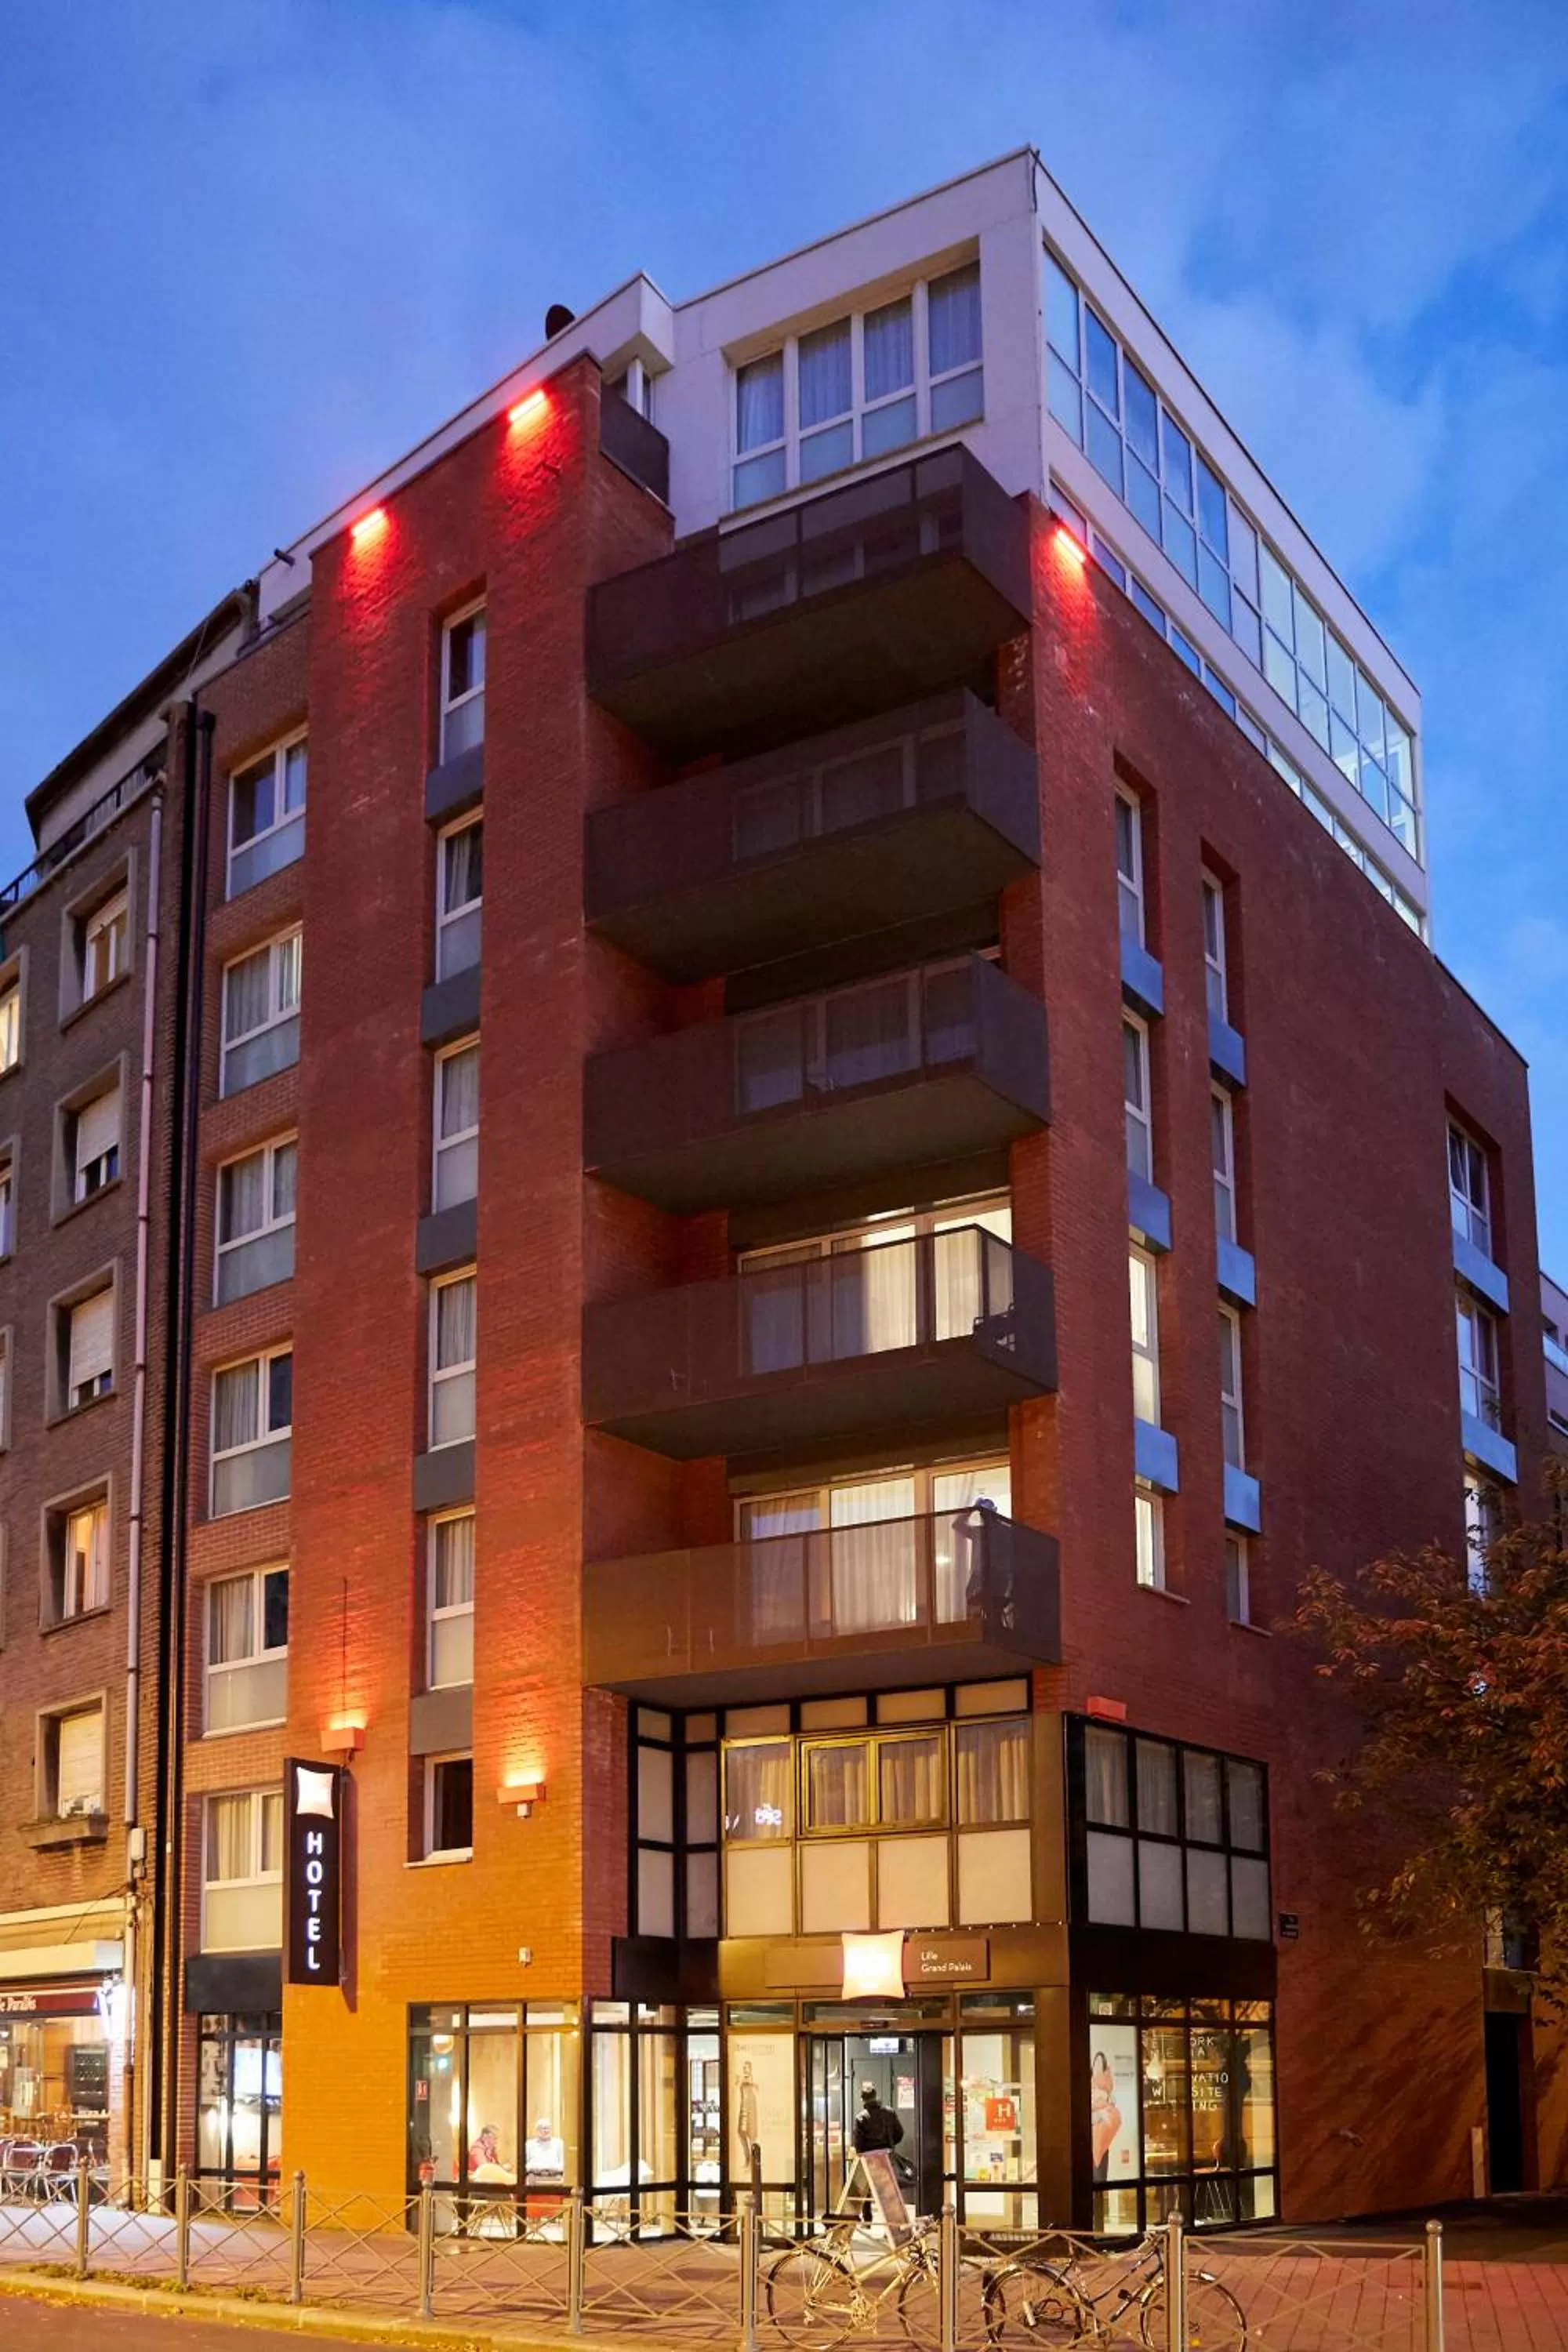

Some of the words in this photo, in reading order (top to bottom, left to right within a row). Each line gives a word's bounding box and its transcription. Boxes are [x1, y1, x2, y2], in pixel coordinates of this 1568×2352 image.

[307, 1831, 323, 1970] HOTEL
[921, 1962, 947, 1973] Grand
[998, 2103, 1011, 2118] H
